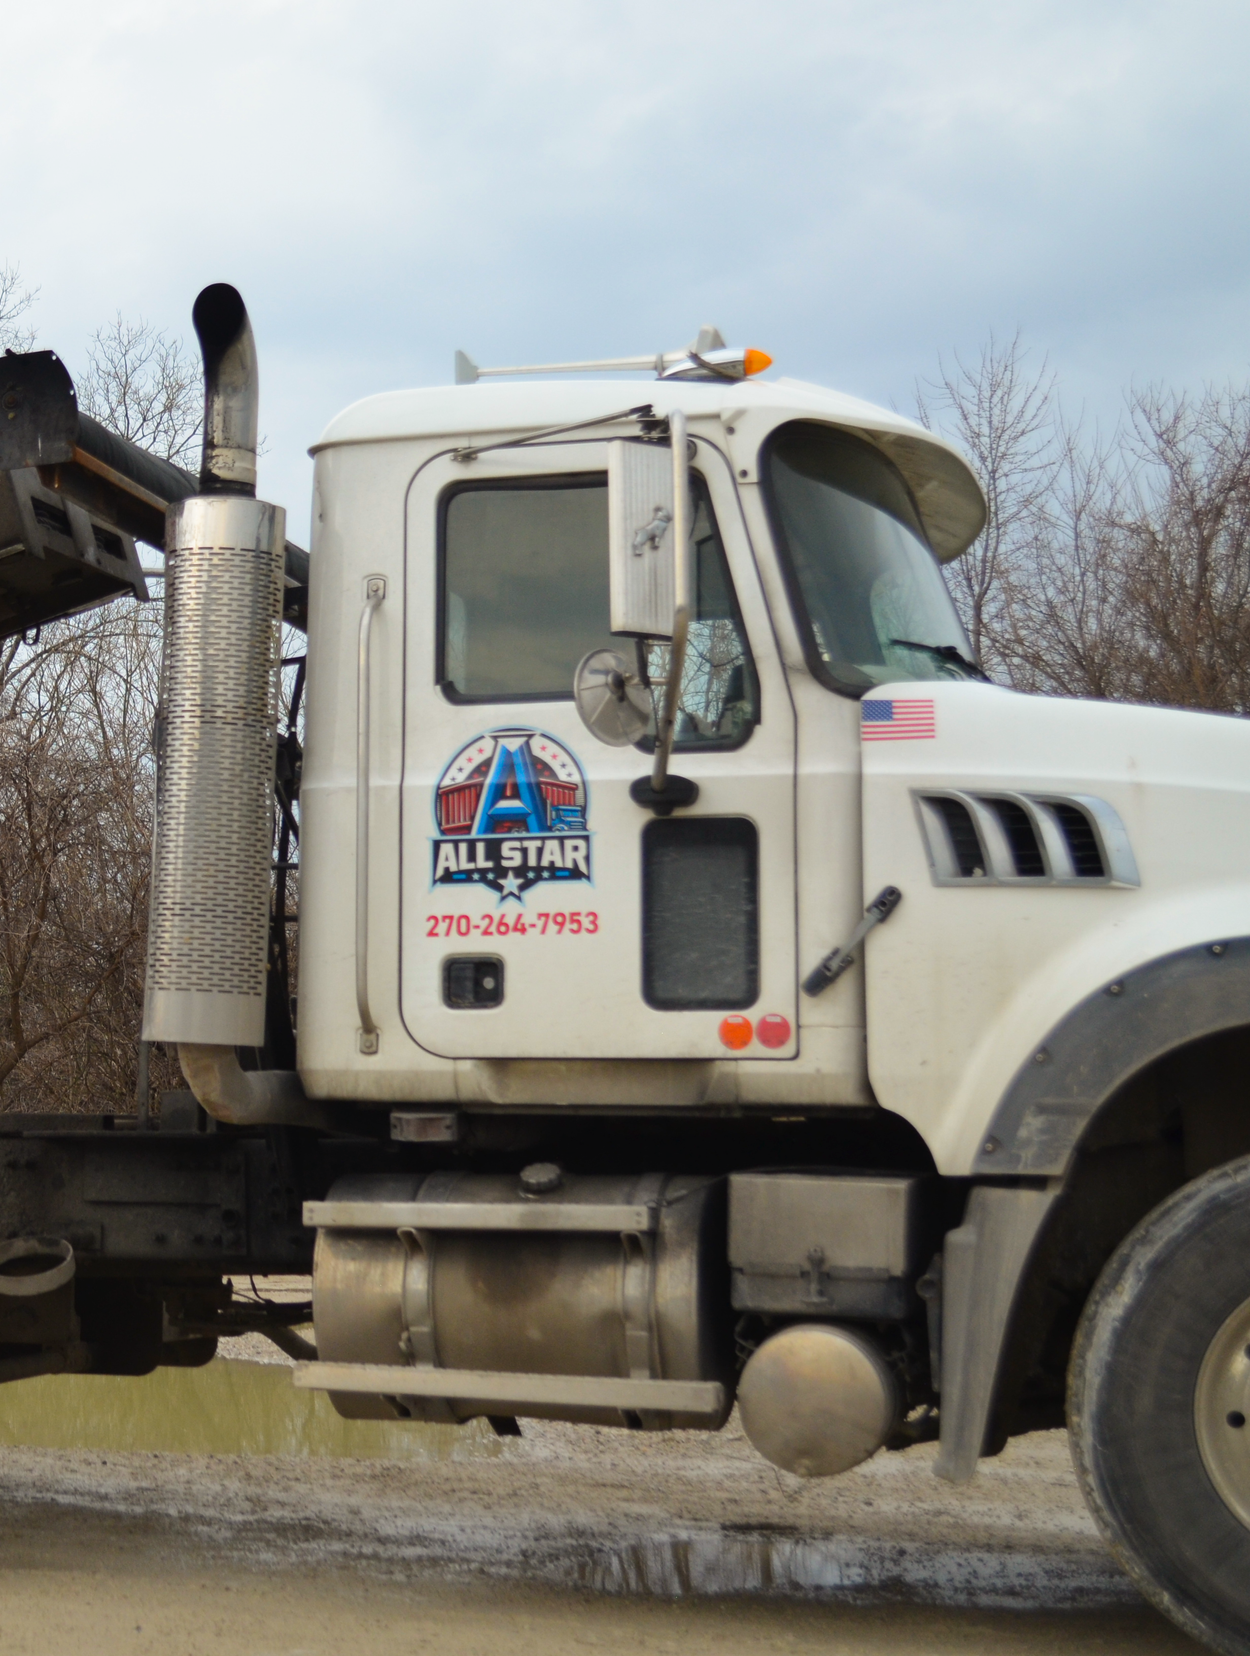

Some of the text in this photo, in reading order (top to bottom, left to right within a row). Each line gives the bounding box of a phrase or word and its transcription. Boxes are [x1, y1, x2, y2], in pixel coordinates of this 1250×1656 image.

[435, 838, 590, 880] ALL STAR
[426, 912, 599, 937] 270-264-7953
